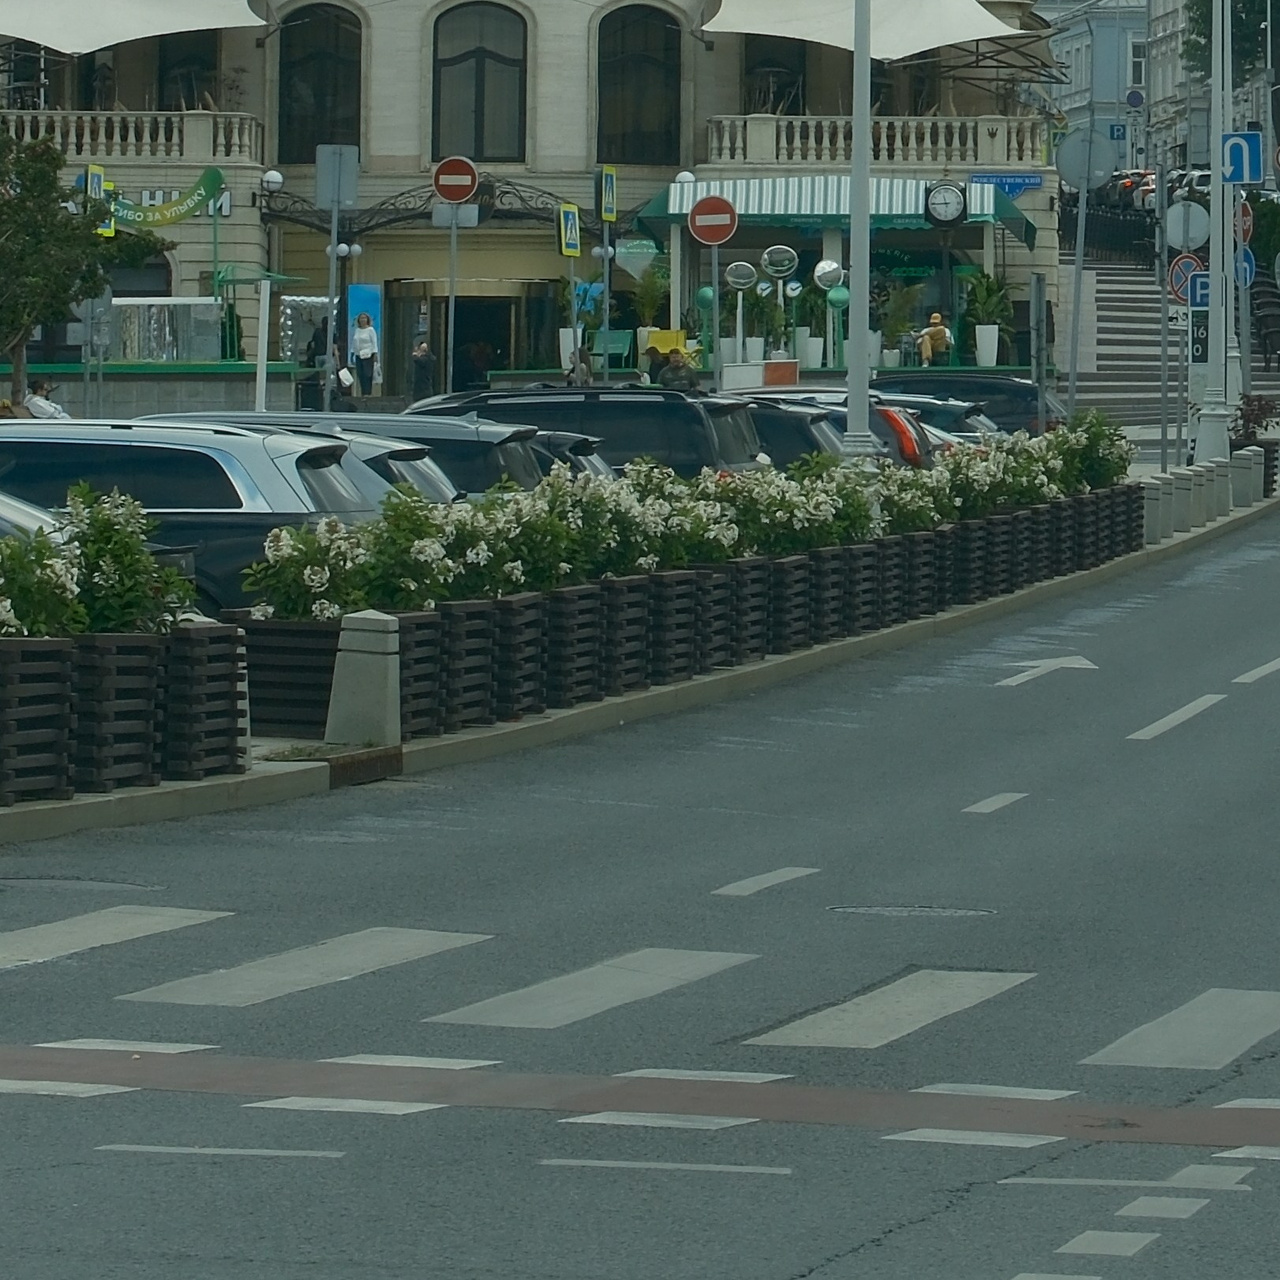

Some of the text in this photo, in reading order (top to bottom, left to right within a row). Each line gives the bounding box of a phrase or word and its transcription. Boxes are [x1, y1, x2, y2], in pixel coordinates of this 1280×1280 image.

[113, 205, 144, 222] СИБО
[146, 212, 162, 221] ЗА
[164, 186, 206, 219] УЛЫБКУ
[1193, 326, 1207, 338] 16
